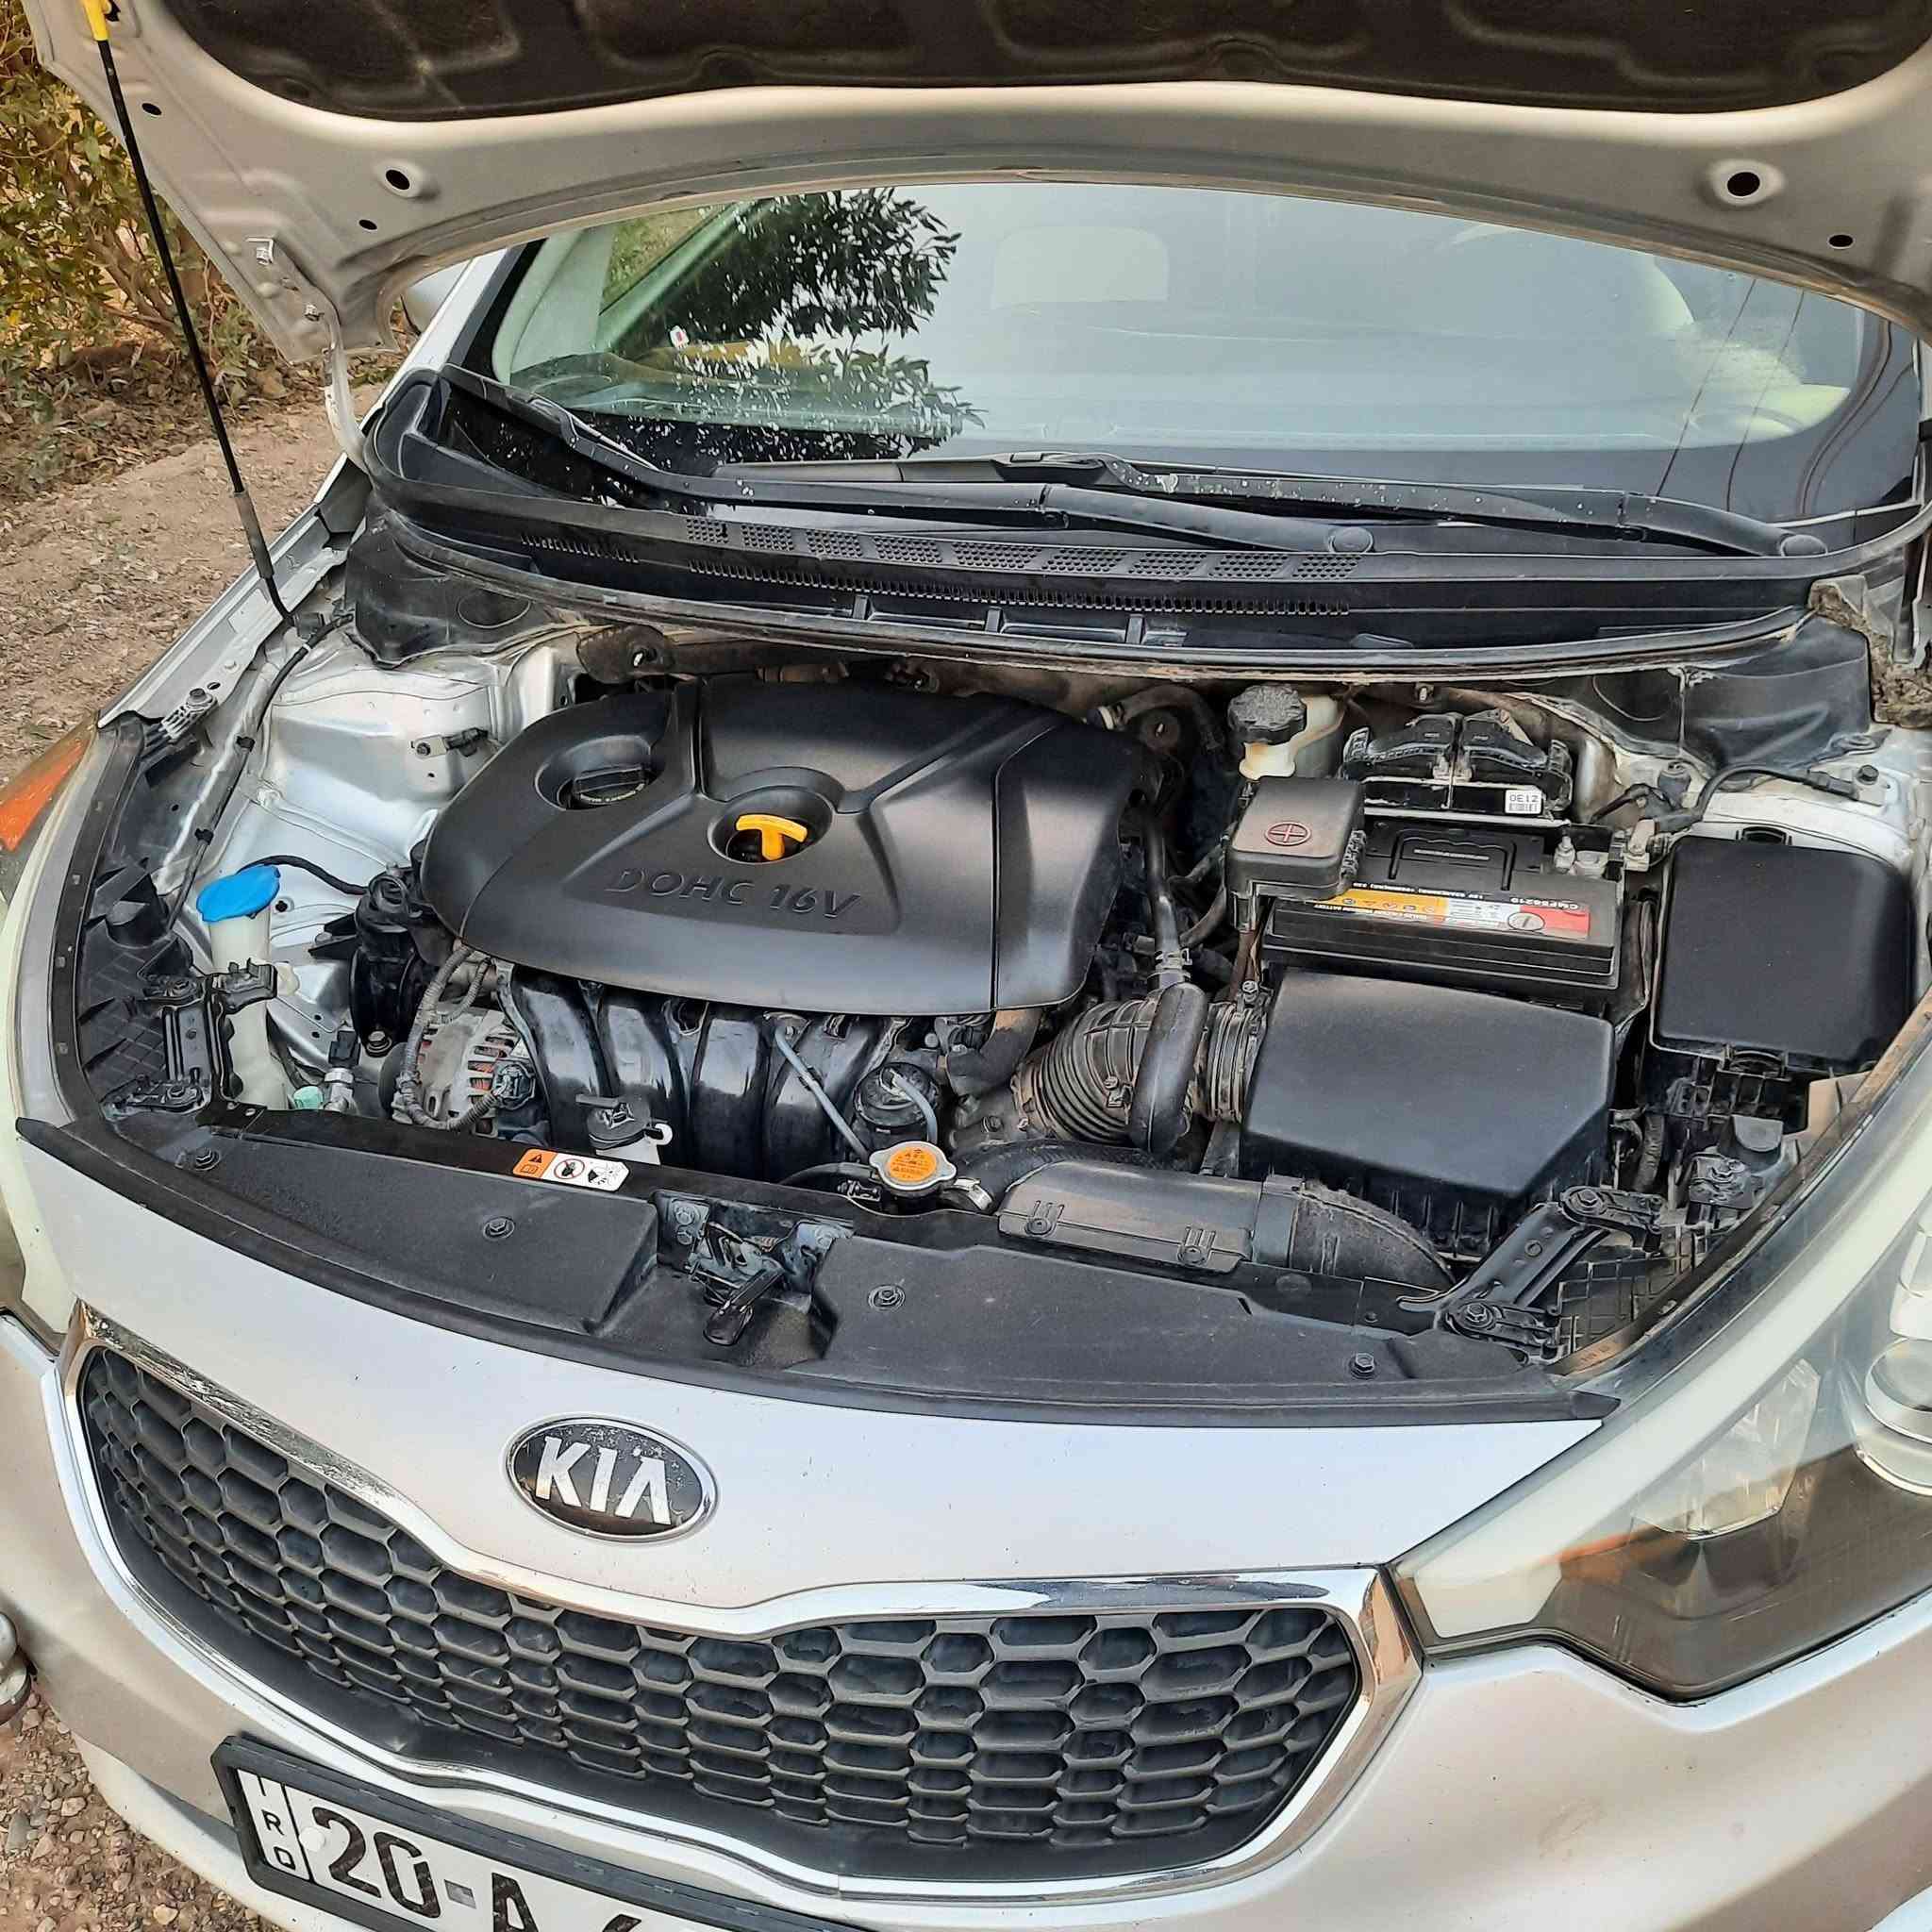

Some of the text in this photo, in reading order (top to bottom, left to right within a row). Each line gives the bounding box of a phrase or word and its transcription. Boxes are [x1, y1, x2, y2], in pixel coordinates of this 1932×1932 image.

[605, 867, 861, 919] DOHC 16V
[535, 1435, 672, 1525] KIA
